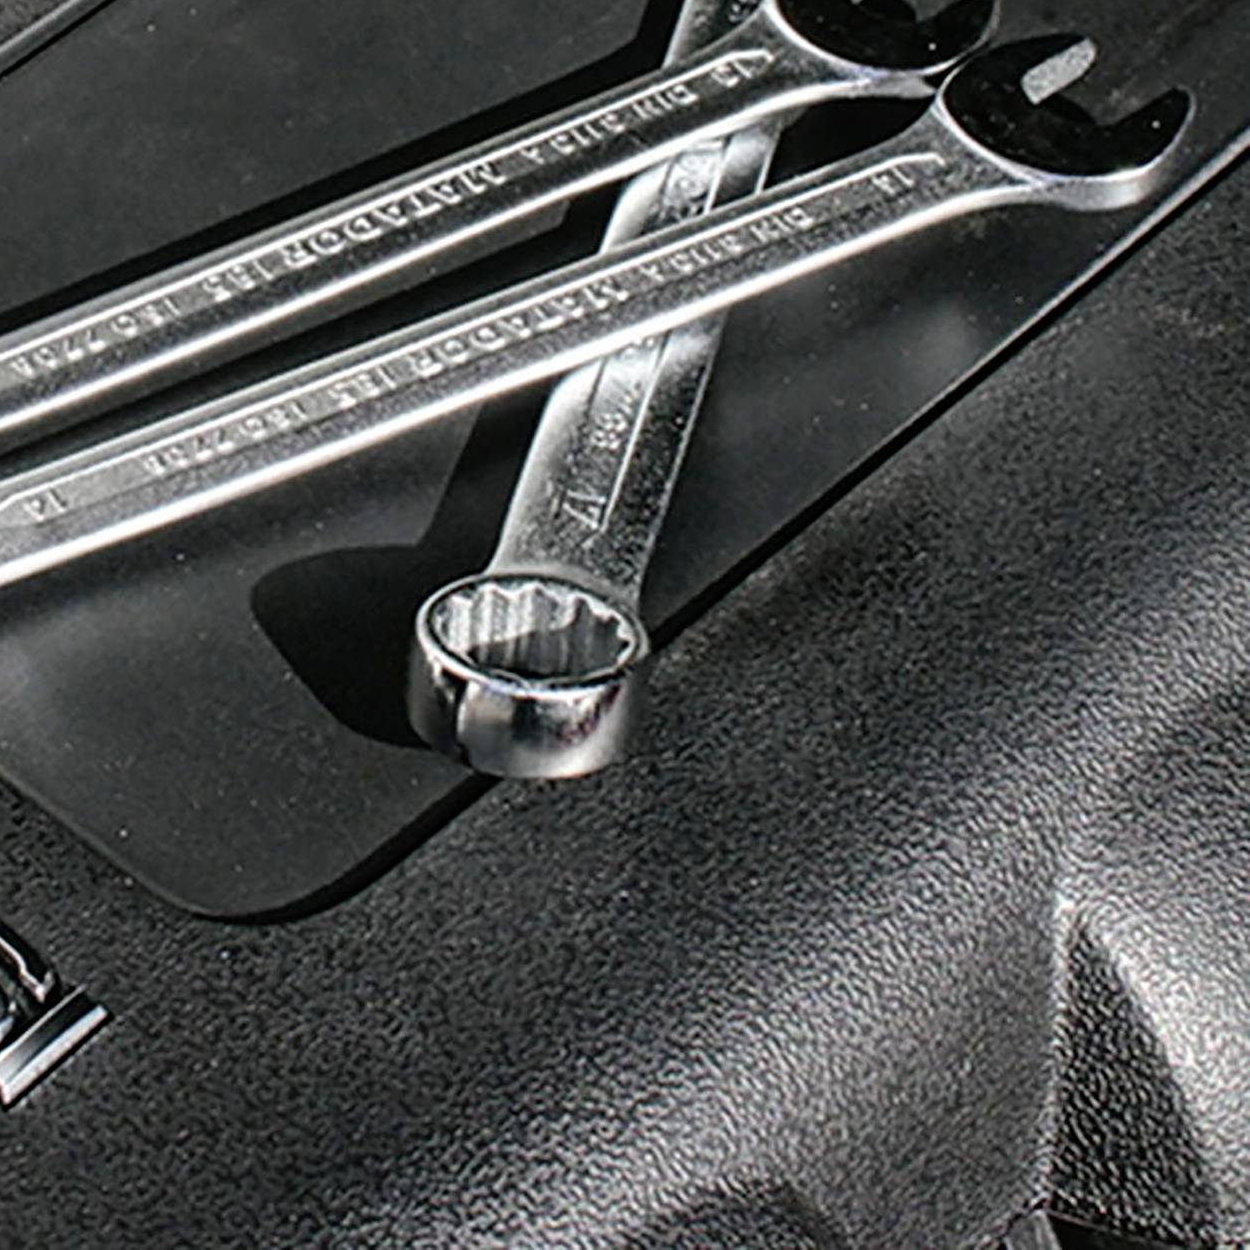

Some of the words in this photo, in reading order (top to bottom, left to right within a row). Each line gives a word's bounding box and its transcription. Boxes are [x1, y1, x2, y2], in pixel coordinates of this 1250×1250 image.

[631, 82, 699, 121] DIN
[281, 160, 507, 269] MATADOR
[405, 276, 631, 378] MATADOR
